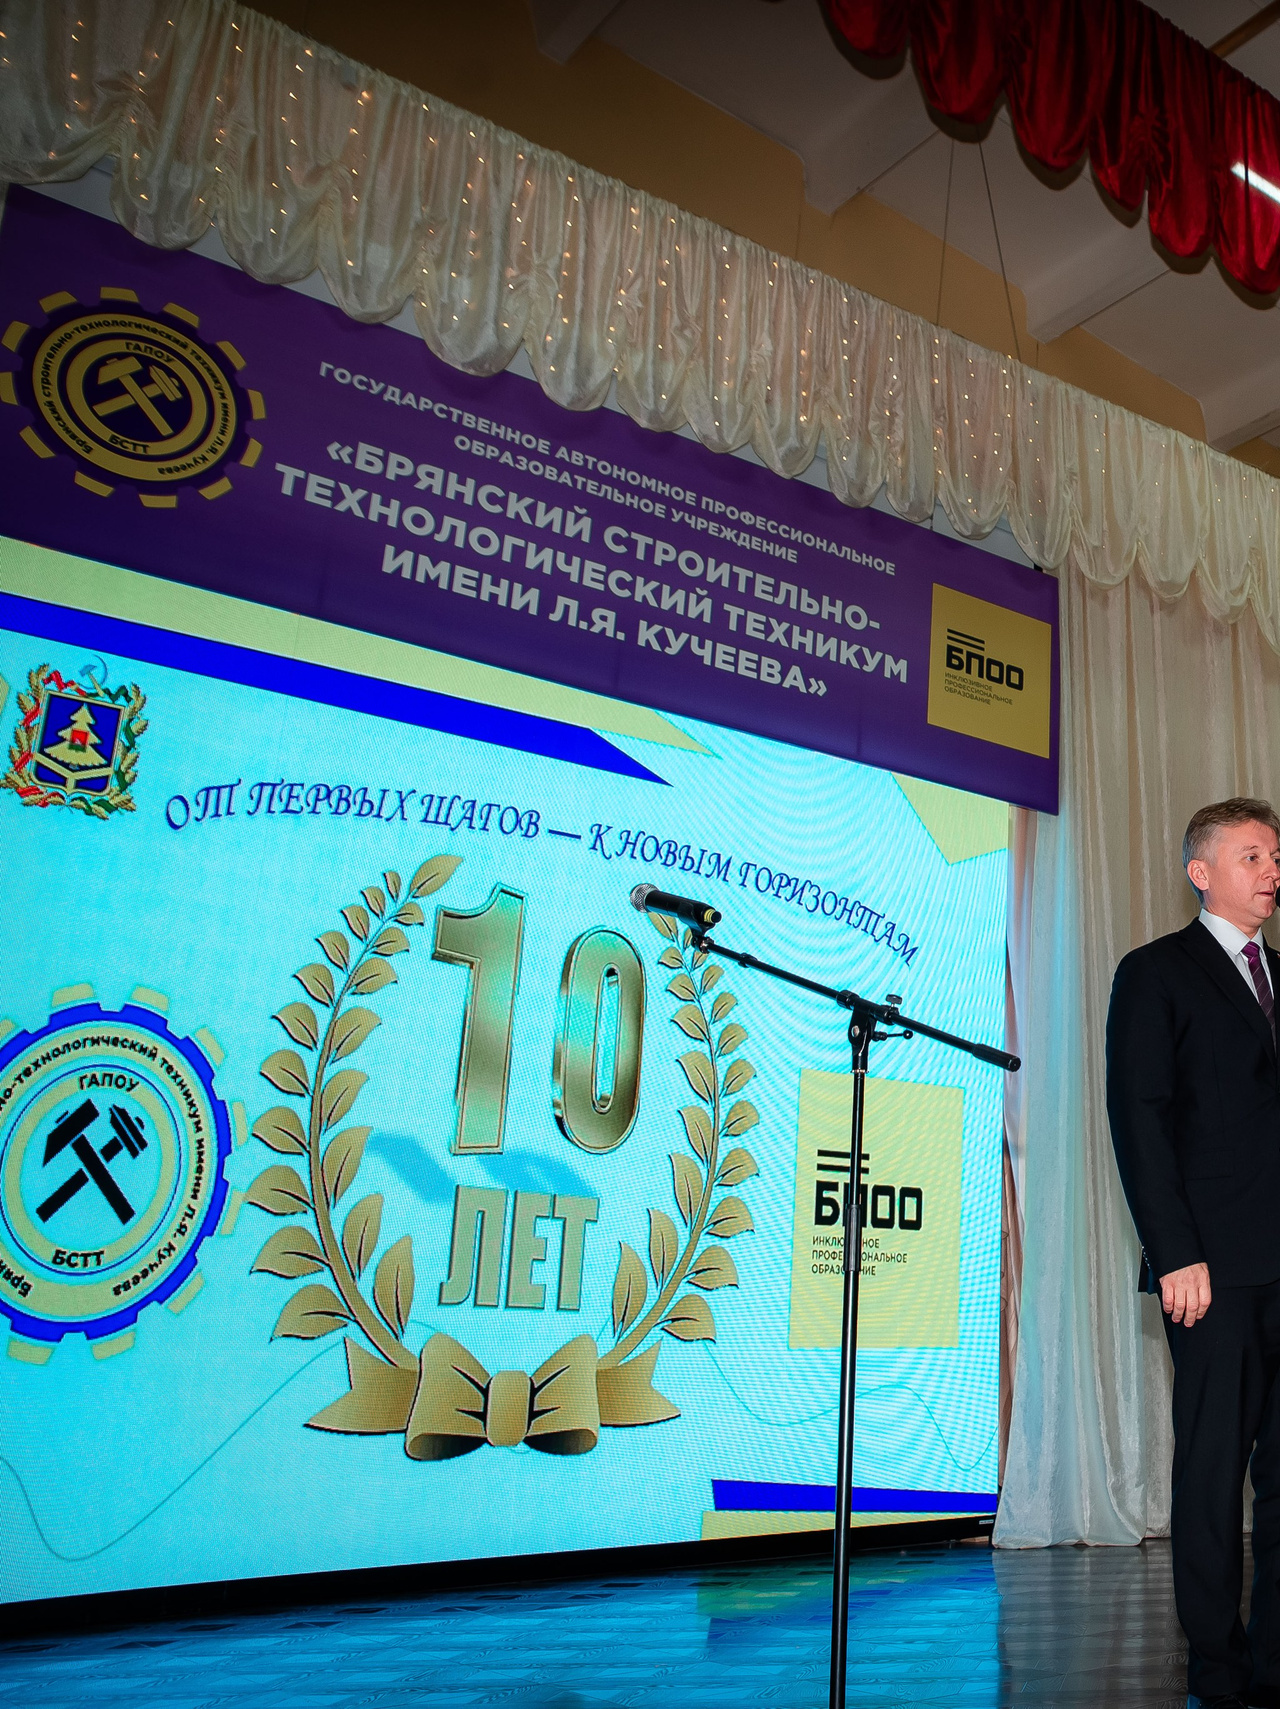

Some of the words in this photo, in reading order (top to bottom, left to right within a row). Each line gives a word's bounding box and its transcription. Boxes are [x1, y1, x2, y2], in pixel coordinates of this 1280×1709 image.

[125, 341, 175, 363] ГАПОУ
[43, 400, 93, 455] Брянский
[108, 434, 150, 454] БСТТ
[319, 361, 551, 455] ГОСУДАРСТВЕННОЕ
[554, 446, 697, 506] АВТОНОМНОЕ
[700, 496, 896, 576] ПРОФЕССИОНАЛЬНОЕ
[453, 435, 667, 518] ОБРАЗОВАТЕЛЬНОЕ
[671, 508, 798, 564] УЧРЕЖДЕНИЕ
[326, 440, 593, 543] «БРЯНСКИЙ
[603, 525, 881, 632] СТРОИТЕЛЬНО-
[275, 462, 713, 623] ТЕХНОЛОГИЧЕСКИЙ
[723, 603, 908, 684] ТЕХНИКУМ
[381, 544, 540, 616] ИМЕНИ
[548, 595, 626, 641] Л.Я.
[637, 619, 828, 697] КУЧЕЕВА»
[944, 671, 993, 692] ИНКЛЮЗИВНОЕ
[946, 643, 1024, 691] БПОО
[944, 679, 1013, 706] ПРОФЕССИОНАЛЬНОЕ
[944, 686, 991, 706] ОБРАЗОВАНИЕ
[165, 779, 242, 831] ОТ
[247, 778, 417, 822] ПЕРВЫХ
[420, 793, 541, 838] ШАГОВ
[590, 823, 613, 860] К
[615, 829, 734, 883] НОВЫМ
[739, 862, 919, 966] ГОРИЗОНТАМ
[432, 882, 648, 1156] 10
[78, 1073, 139, 1093] ГАПОУ
[160, 1057, 204, 1134] техникум
[187, 1137, 205, 1200] имени
[51, 1249, 105, 1268] БСТТ
[438, 1184, 600, 1311] ЛЕТ
[811, 1249, 908, 1263] ПРОФЕОНАЛЬНОЕ
[812, 1235, 880, 1249] ИНКЛЮНОЕ
[811, 1263, 876, 1276] ОБРАЗНИЕ
